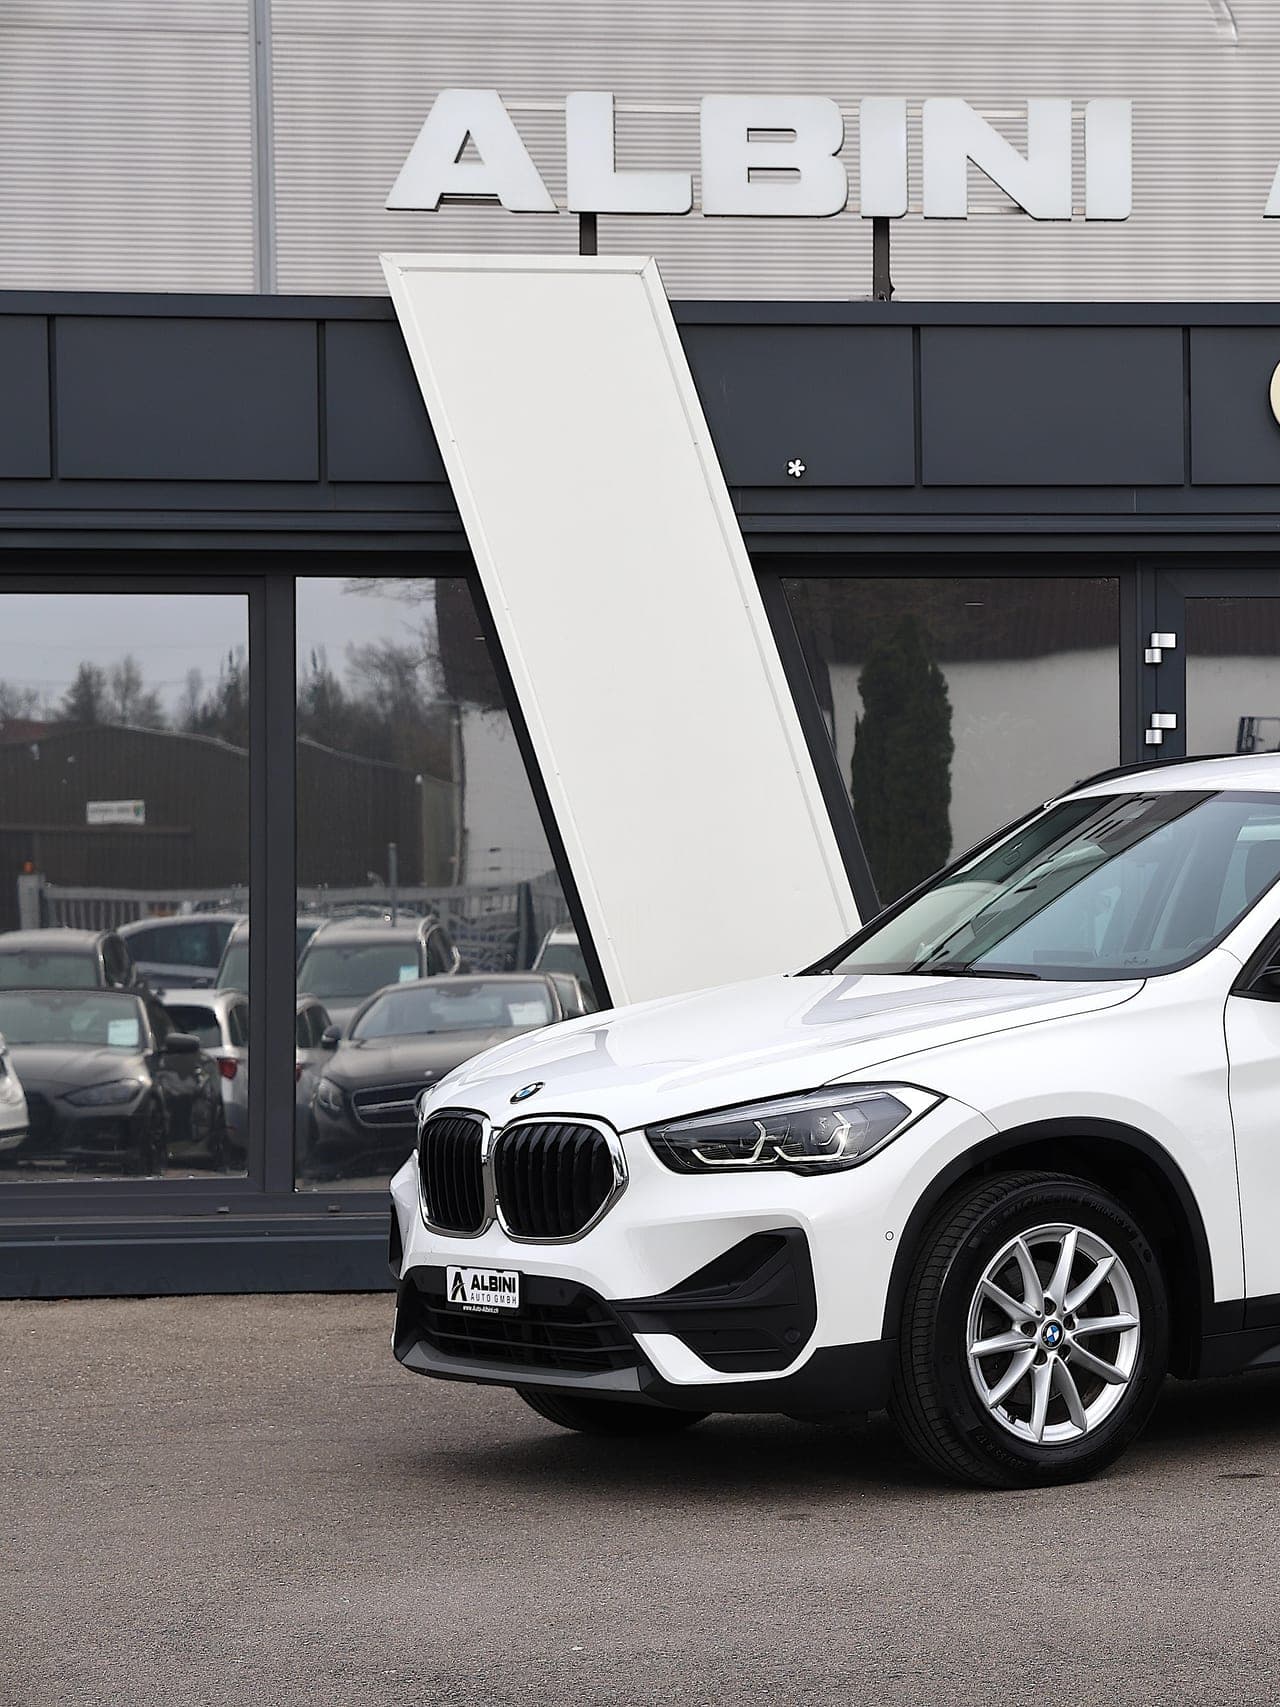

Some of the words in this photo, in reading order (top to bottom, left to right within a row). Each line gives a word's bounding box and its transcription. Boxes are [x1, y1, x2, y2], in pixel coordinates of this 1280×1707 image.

[385, 88, 1133, 221] ALBINI
[471, 1274, 516, 1293] ALBINI
[470, 1292, 491, 1303] AUTO
[493, 1294, 517, 1305] GMBH
